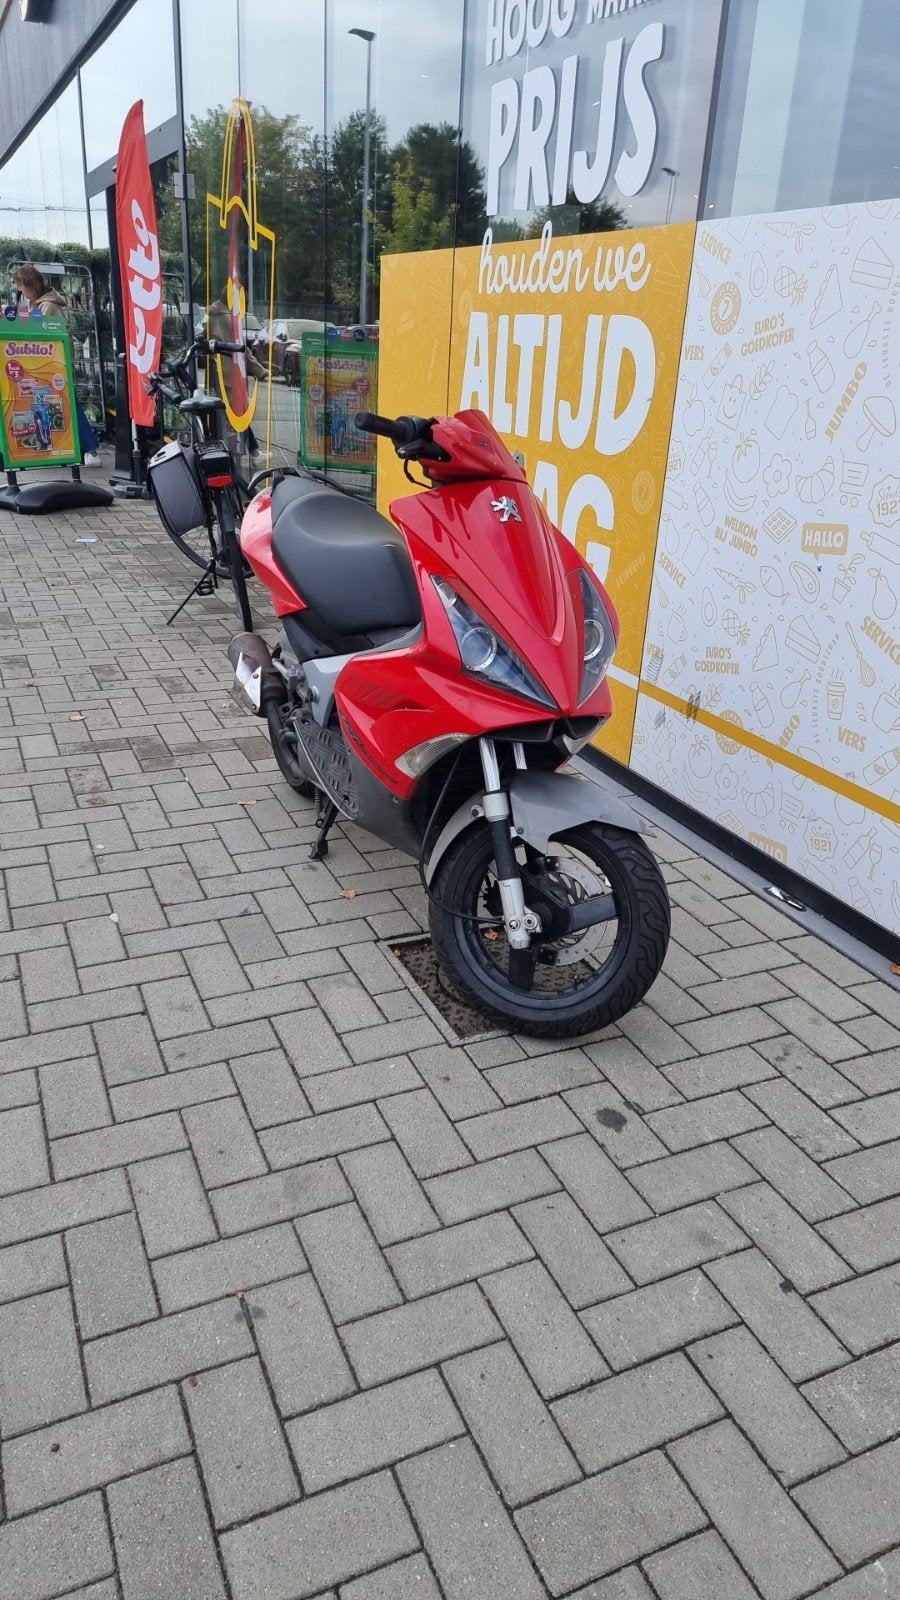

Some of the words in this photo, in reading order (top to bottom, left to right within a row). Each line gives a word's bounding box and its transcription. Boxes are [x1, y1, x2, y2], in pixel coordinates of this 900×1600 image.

[486, 0, 577, 66] HOOG
[486, 23, 665, 216] PRIJS
[478, 220, 590, 294] houden
[594, 242, 652, 292] we
[699, 231, 733, 267] SERVICE
[753, 312, 786, 336] EURO'S
[5, 341, 54, 357] Subito!
[684, 344, 706, 362] VERS
[740, 327, 796, 357] GOEDKOPER
[459, 311, 656, 456] ALTIJD
[824, 362, 868, 444] JUMBO
[876, 500, 900, 518] 192
[724, 513, 758, 541] WELKOM
[804, 529, 845, 549] HALLO
[728, 534, 758, 558] JUMBO
[657, 552, 687, 590] SERVICE
[706, 646, 732, 660] EURO'S
[860, 615, 900, 667] SERVIC
[694, 660, 740, 676] GOEDKOPER
[837, 726, 867, 752] VERS
[809, 837, 833, 852] 1921
